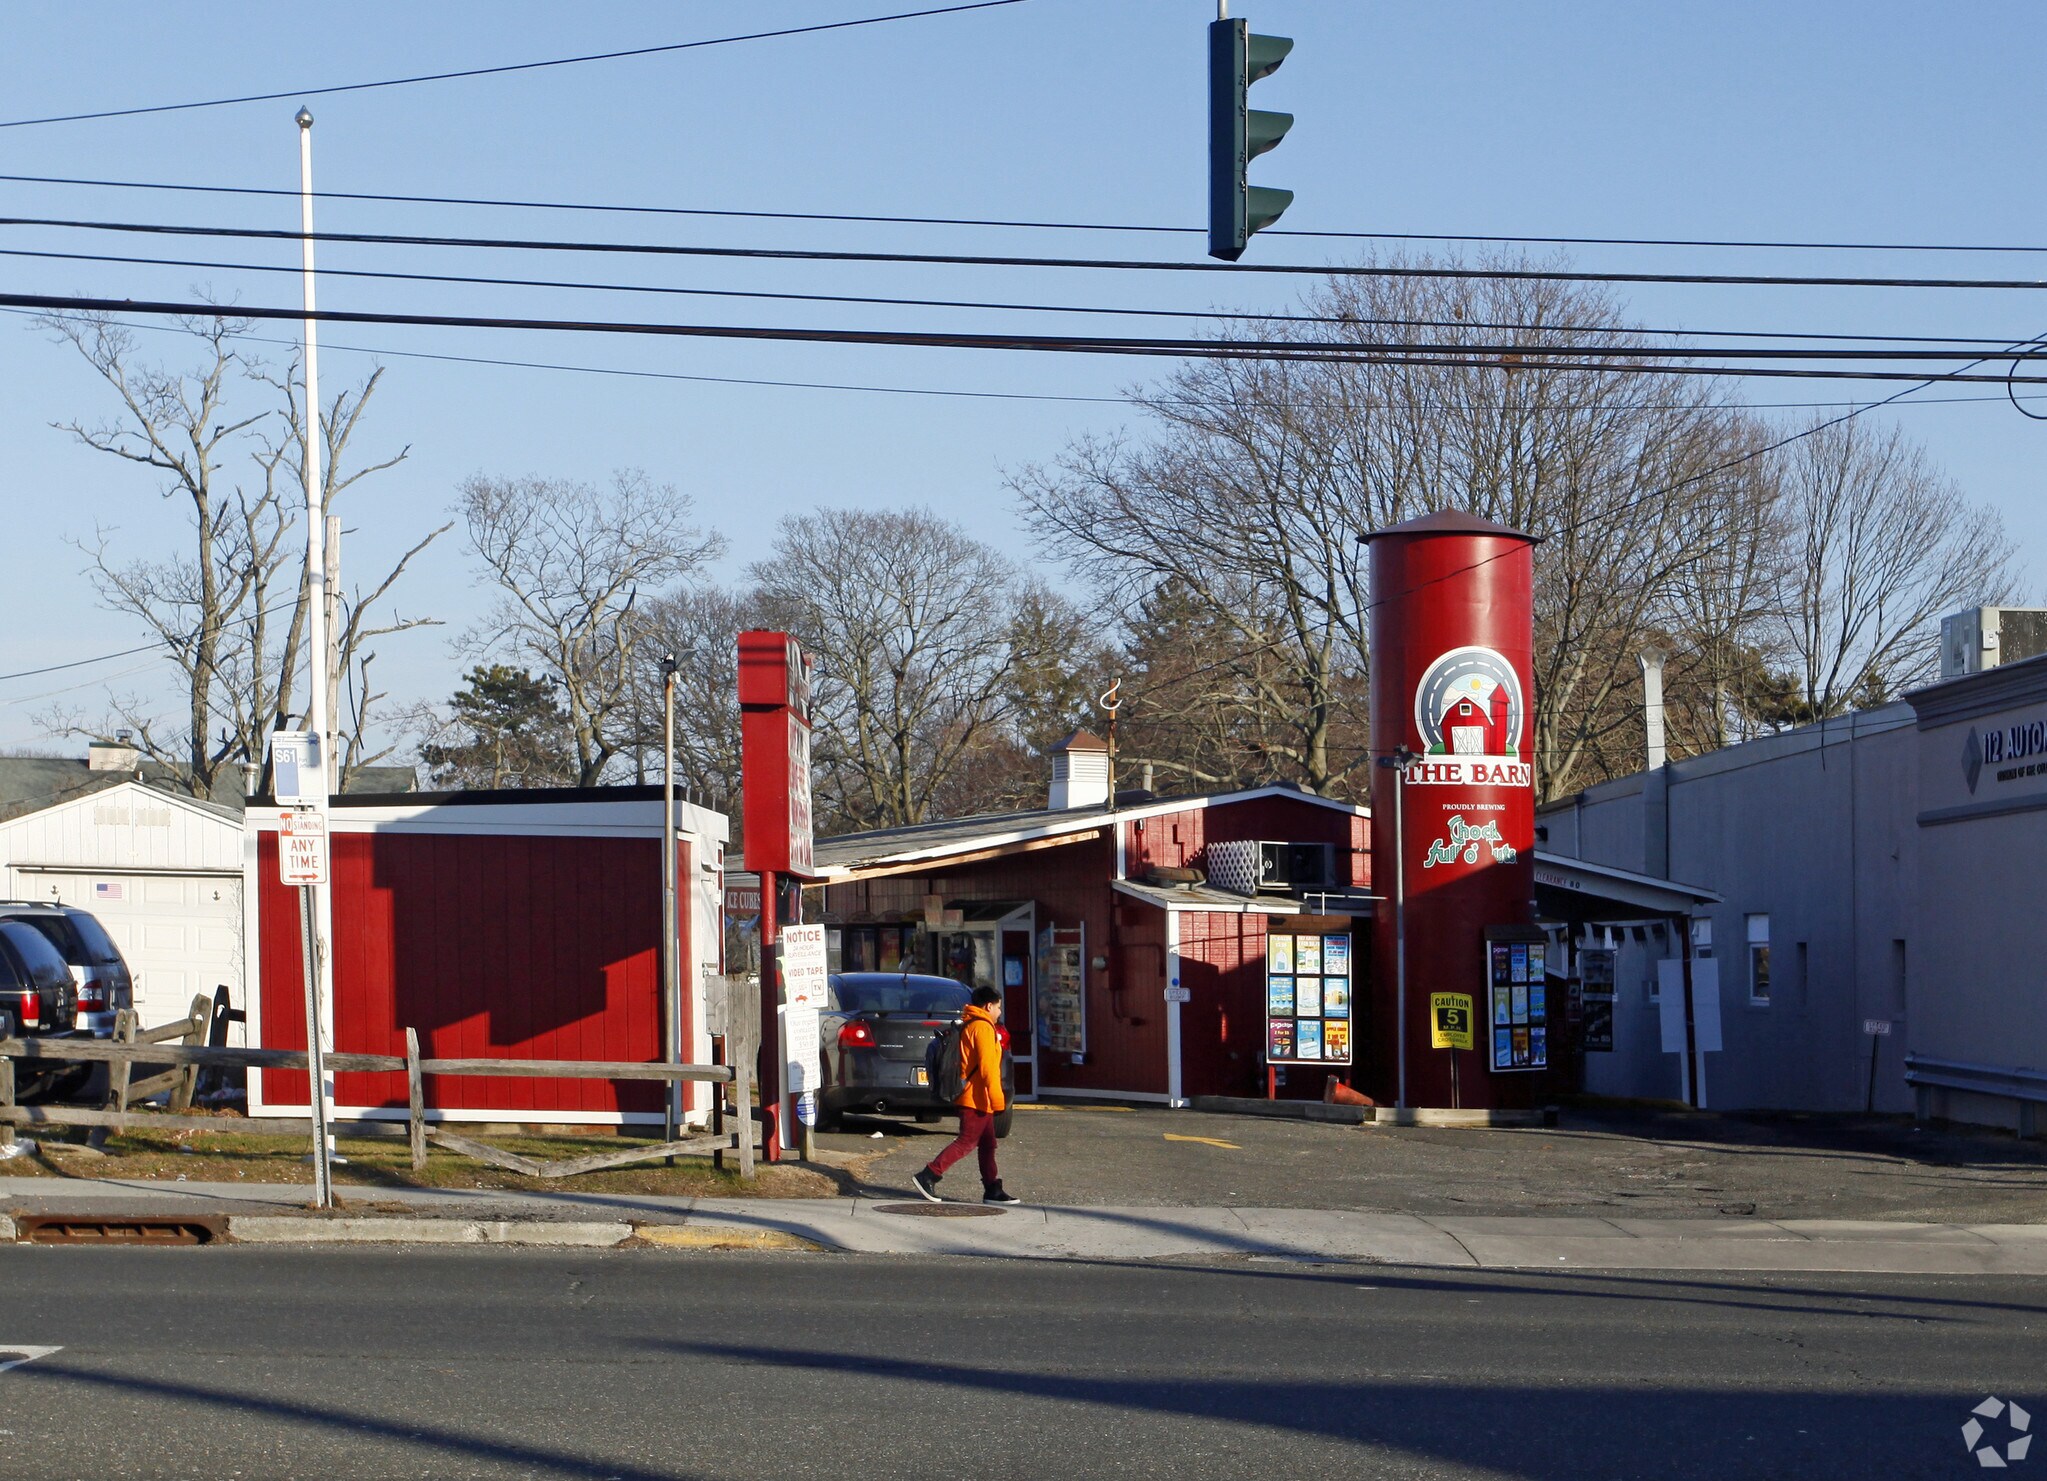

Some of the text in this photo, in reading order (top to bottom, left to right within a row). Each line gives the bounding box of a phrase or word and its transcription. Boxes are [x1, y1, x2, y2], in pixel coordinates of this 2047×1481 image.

[1983, 730, 2003, 764] 112
[275, 749, 296, 763] S61
[1403, 763, 1529, 785] THE BARN
[1442, 803, 1476, 811] PROUDLY
[280, 817, 323, 832] NO STANDING
[1447, 814, 1503, 844] Chock
[290, 839, 315, 852] ANY
[1423, 838, 1461, 868] full
[289, 855, 319, 869] TIME
[1535, 871, 1568, 887] CLEARANCE
[727, 891, 738, 909] ICE
[786, 930, 821, 944] NOTICE
[788, 966, 823, 978] VIDEO TAPE
[1435, 997, 1469, 1008] CAUTION
[1446, 1009, 1459, 1025] 5
